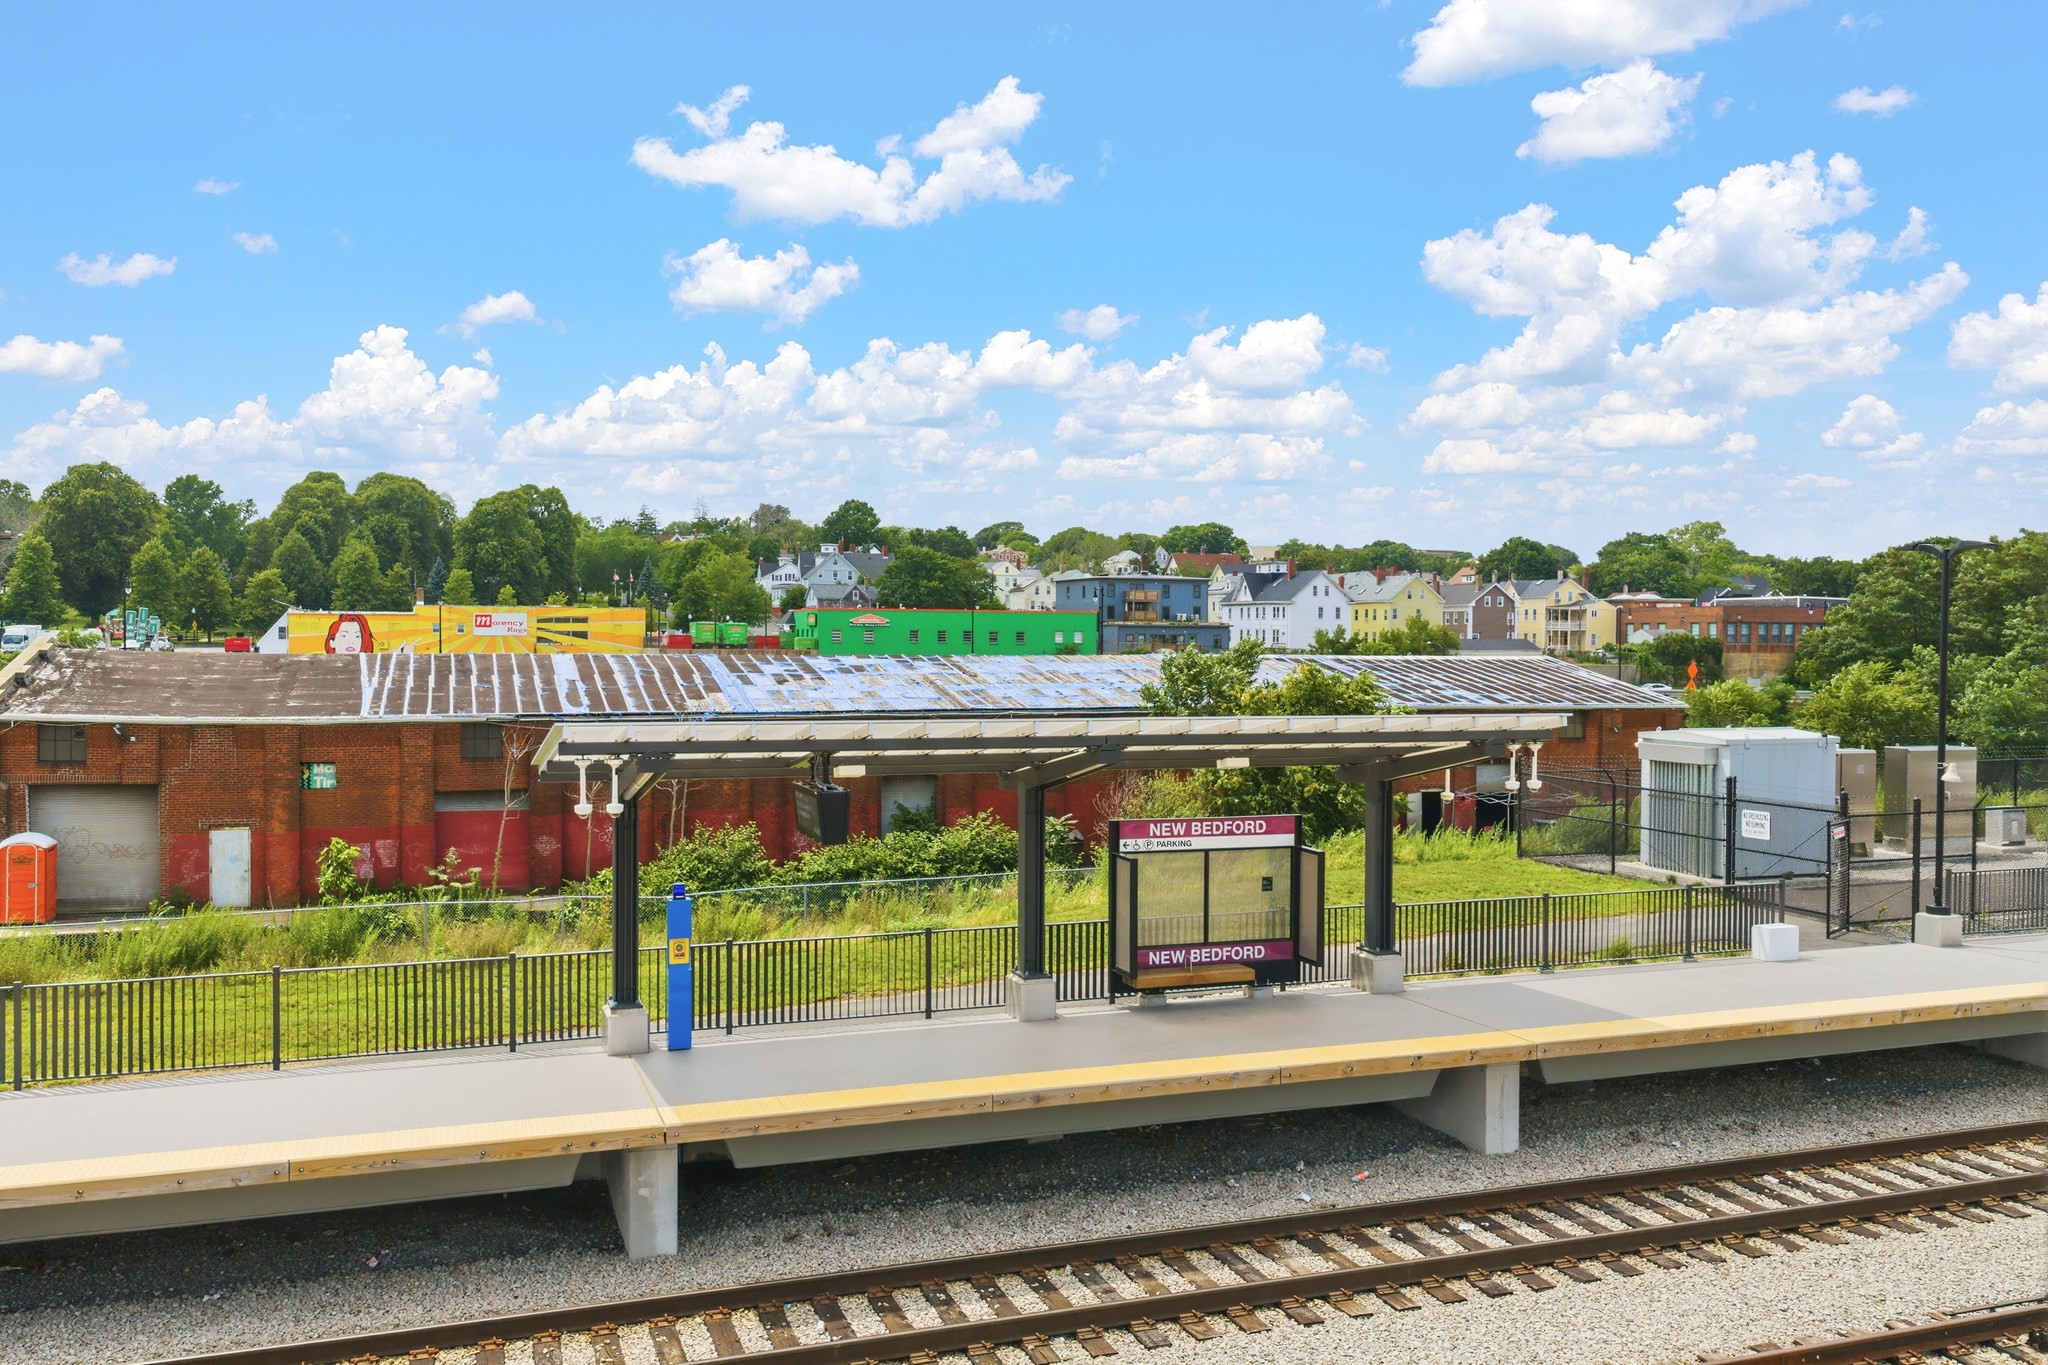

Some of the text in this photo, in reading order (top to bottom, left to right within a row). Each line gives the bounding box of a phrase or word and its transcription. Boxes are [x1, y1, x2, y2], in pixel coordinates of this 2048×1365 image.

[1149, 820, 1267, 837] NEW BEDFORD
[1156, 839, 1192, 848] PARKING
[1148, 945, 1265, 965] NEW BEDFORD
